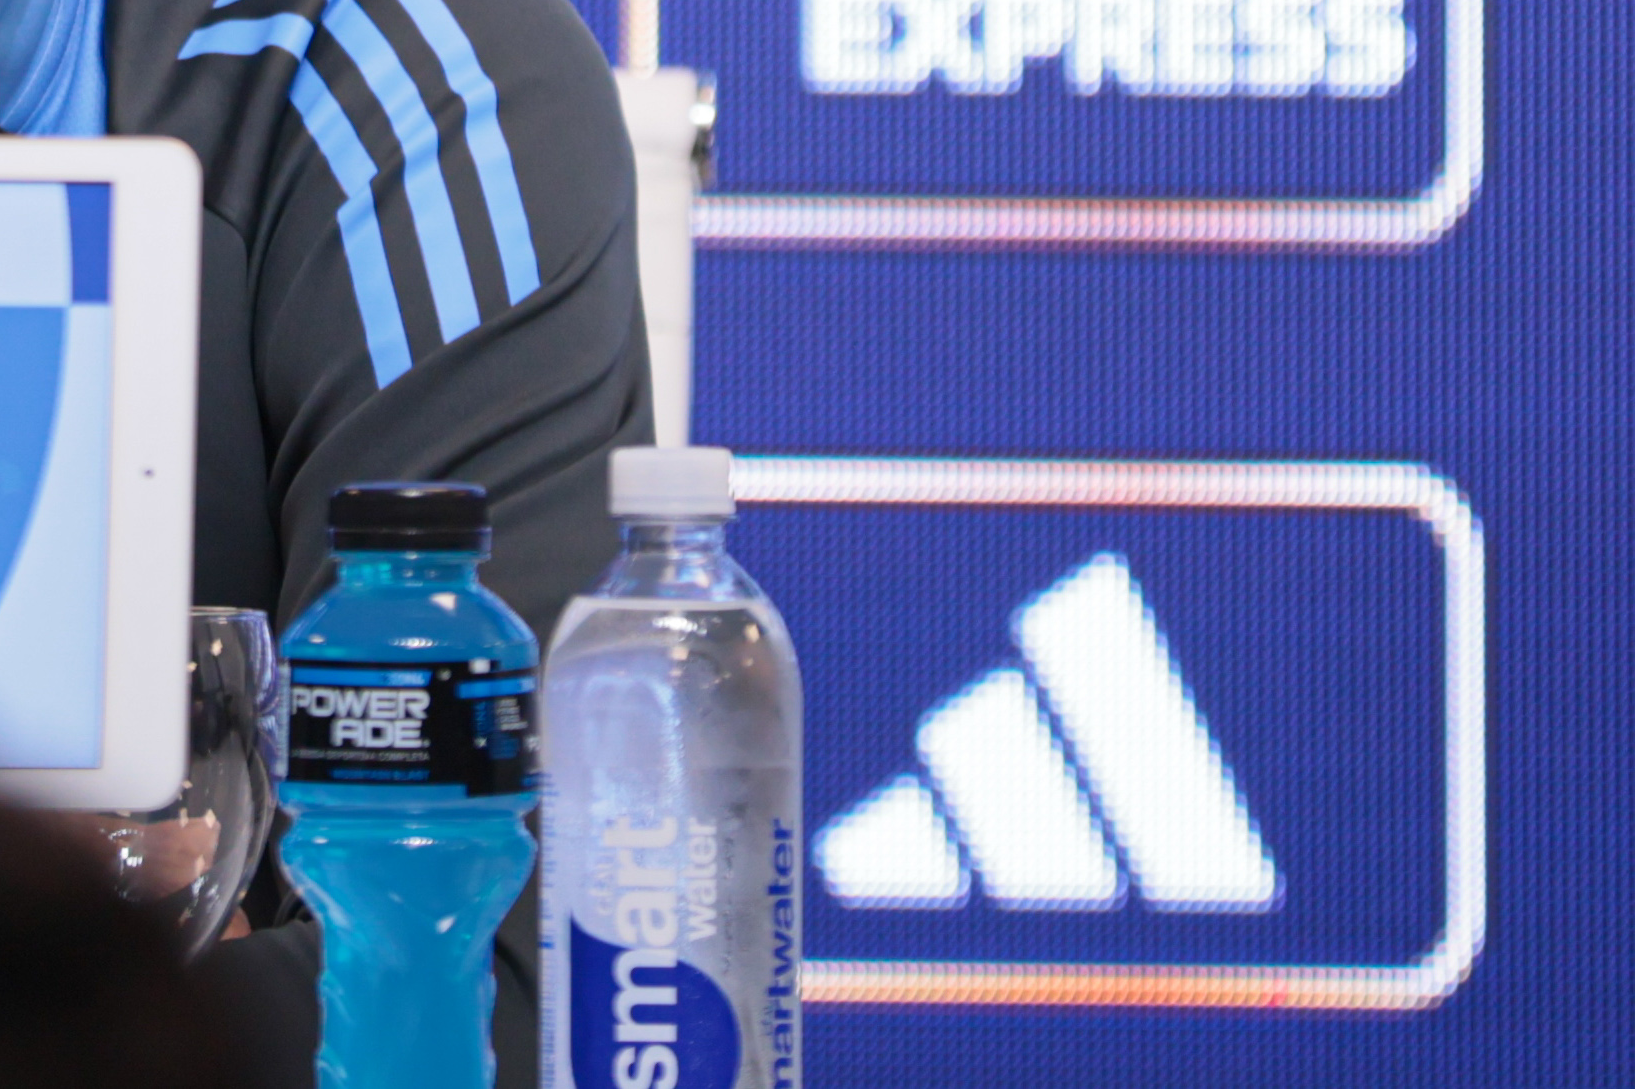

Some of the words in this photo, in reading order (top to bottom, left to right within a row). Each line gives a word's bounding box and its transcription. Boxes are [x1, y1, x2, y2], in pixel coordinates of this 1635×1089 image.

[291, 687, 431, 720] POWER
[603, 815, 679, 1089] smart
[681, 815, 717, 942] water
[767, 817, 794, 1089] martwater
